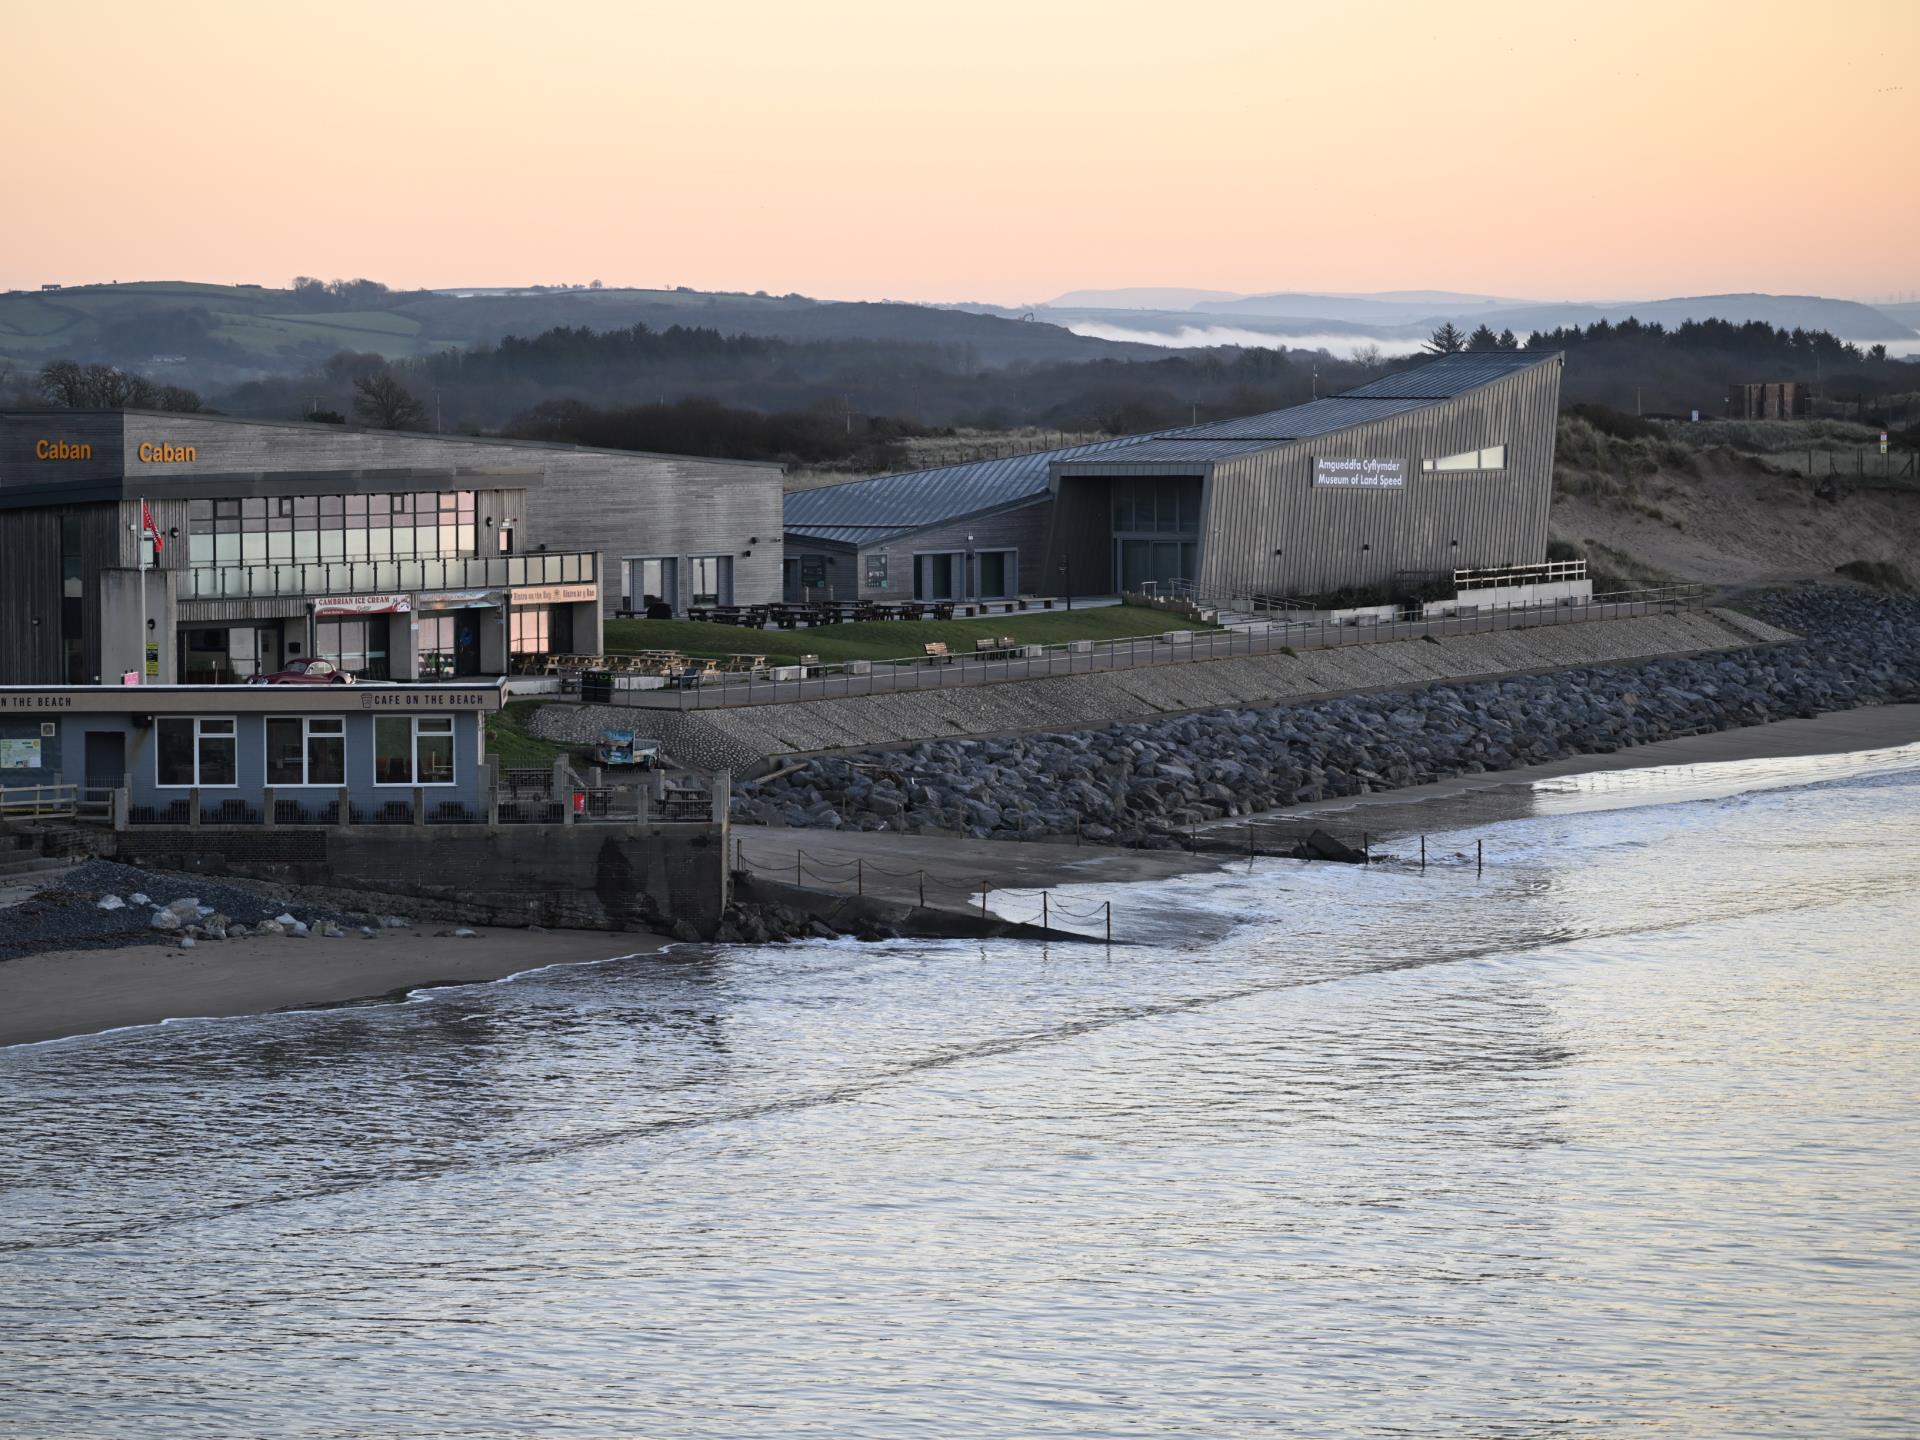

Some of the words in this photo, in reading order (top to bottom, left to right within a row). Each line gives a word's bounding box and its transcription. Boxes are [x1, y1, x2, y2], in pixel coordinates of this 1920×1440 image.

[35, 439, 92, 461] Caban
[138, 441, 196, 463] Caban
[1318, 458, 1361, 472] Amgueddfa
[1362, 459, 1400, 473] Cyflymder
[1318, 473, 1349, 485] Museum
[1350, 474, 1359, 485] of
[1360, 474, 1378, 485] Land
[1379, 475, 1402, 488] Speed
[318, 597, 353, 606] CAMBRIAN
[354, 597, 366, 605] ICE
[367, 596, 390, 604] CREAM
[0, 697, 7, 707] N
[13, 697, 32, 707] THE
[38, 697, 71, 707] BEACH
[374, 695, 400, 705] CAFE
[406, 695, 419, 705] ON
[425, 695, 444, 705] THE
[449, 695, 484, 705] BEACH
